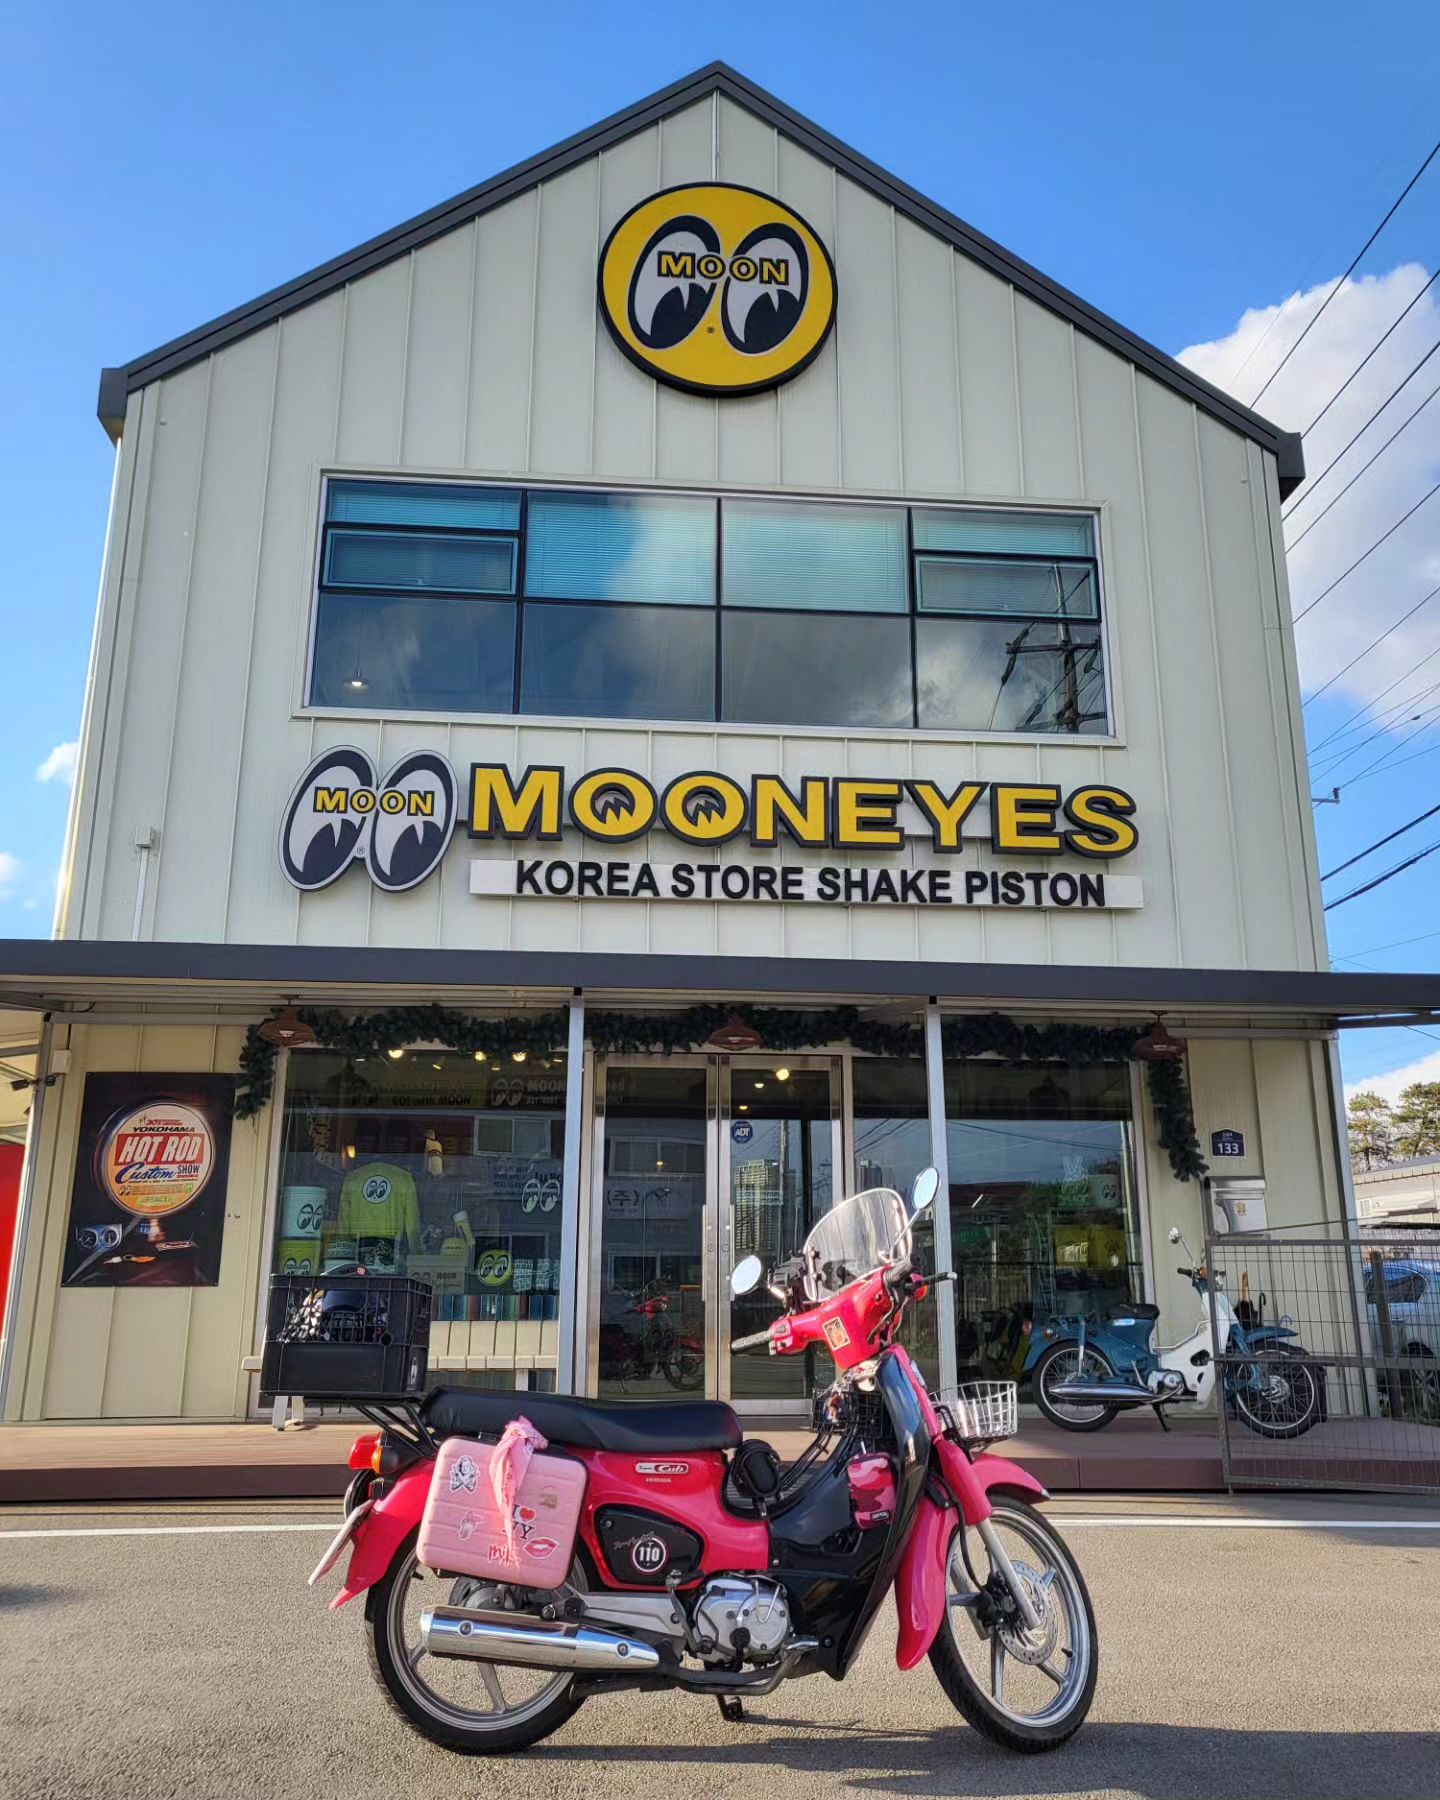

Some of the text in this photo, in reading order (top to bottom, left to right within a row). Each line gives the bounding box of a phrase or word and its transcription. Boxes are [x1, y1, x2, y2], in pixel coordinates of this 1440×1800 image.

[657, 251, 789, 285] MOON
[312, 786, 435, 817] MOON
[467, 762, 1139, 859] MOONEYES
[516, 859, 1106, 907] KOREA STORE SHAKE PISTON
[734, 1128, 750, 1137] ADT
[118, 1135, 202, 1163] HOT ROD
[1217, 1142, 1239, 1154] 133
[115, 1162, 200, 1185] Custom SHOW
[658, 1464, 684, 1473] Cub
[639, 1547, 661, 1562] 110
